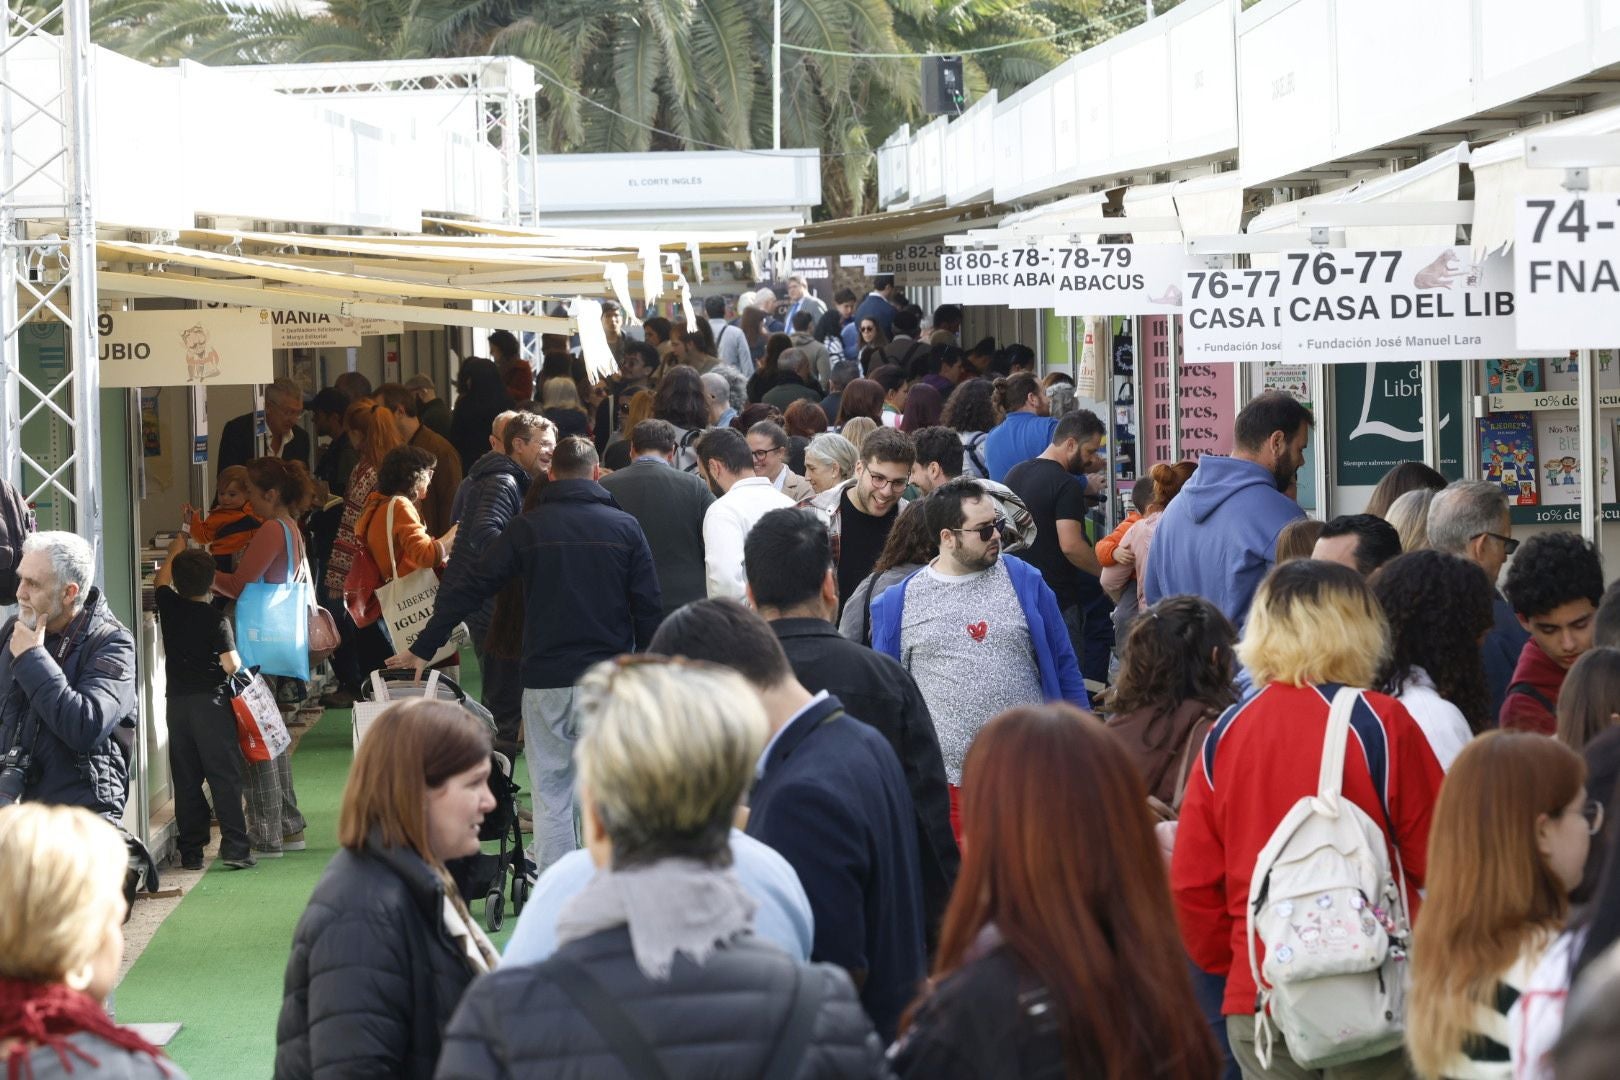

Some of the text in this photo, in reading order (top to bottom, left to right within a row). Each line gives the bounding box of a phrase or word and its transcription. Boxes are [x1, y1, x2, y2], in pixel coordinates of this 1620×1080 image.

[628, 178, 639, 187] EL
[641, 177, 670, 186] CORTE
[1526, 199, 1620, 243] 74-
[1012, 248, 1054, 267] 78-
[1058, 247, 1132, 268] 78-79
[1287, 250, 1402, 285] 76-77
[1530, 260, 1620, 293] FNA
[1013, 272, 1054, 287] ABA
[1059, 273, 1144, 291] ABACUS
[1187, 270, 1280, 299] 76-77
[1289, 291, 1514, 321] CASA DEL LIB
[1189, 307, 1265, 329] CASA
[1204, 341, 1257, 352] Fundación
[1307, 335, 1481, 350] Fundación José Manuel Lara
[1384, 378, 1424, 397] Libr
[1535, 395, 1560, 407] 10%
[1536, 509, 1562, 521] 10%
[393, 605, 435, 632] IGUAL
